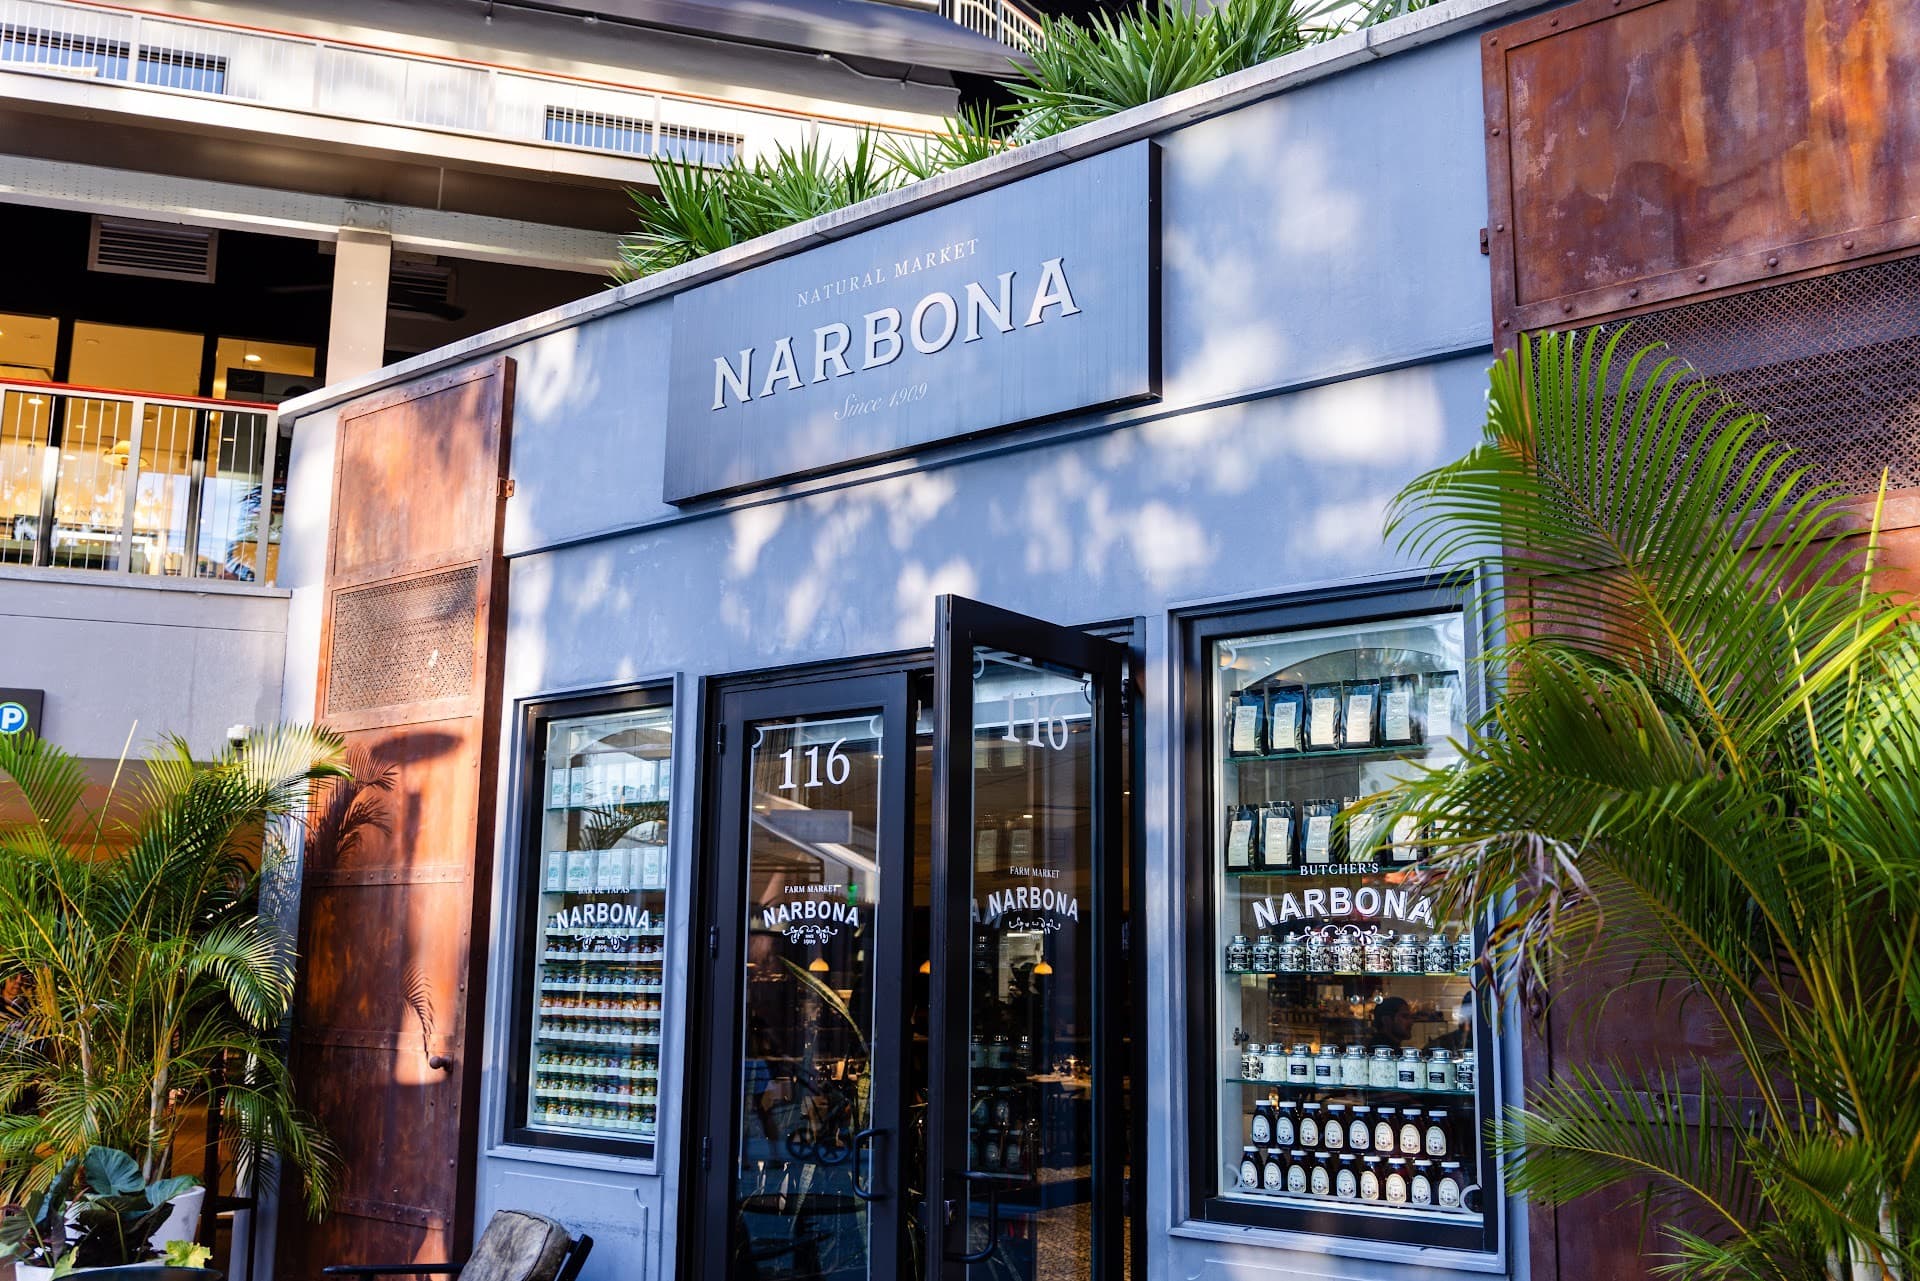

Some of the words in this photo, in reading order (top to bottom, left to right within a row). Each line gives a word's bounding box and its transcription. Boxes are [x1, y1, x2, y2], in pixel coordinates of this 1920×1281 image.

[797, 268, 885, 307] NATURAL
[894, 238, 979, 278] MARKET
[711, 256, 1082, 411] NARBONA
[834, 392, 884, 421] Since
[889, 382, 928, 410] 1909
[1, 708, 22, 729] P
[778, 737, 850, 789] 116
[1010, 866, 1030, 876] FARM
[1032, 867, 1060, 879] MARKET
[1300, 862, 1379, 876] BUTCHER'S
[784, 885, 805, 894] FARM
[807, 884, 838, 893] MARKET
[988, 886, 1079, 922] NARBONA
[557, 902, 650, 931] NARBONA
[763, 900, 860, 928] NARBONA
[1252, 886, 1434, 929] NARBONA
